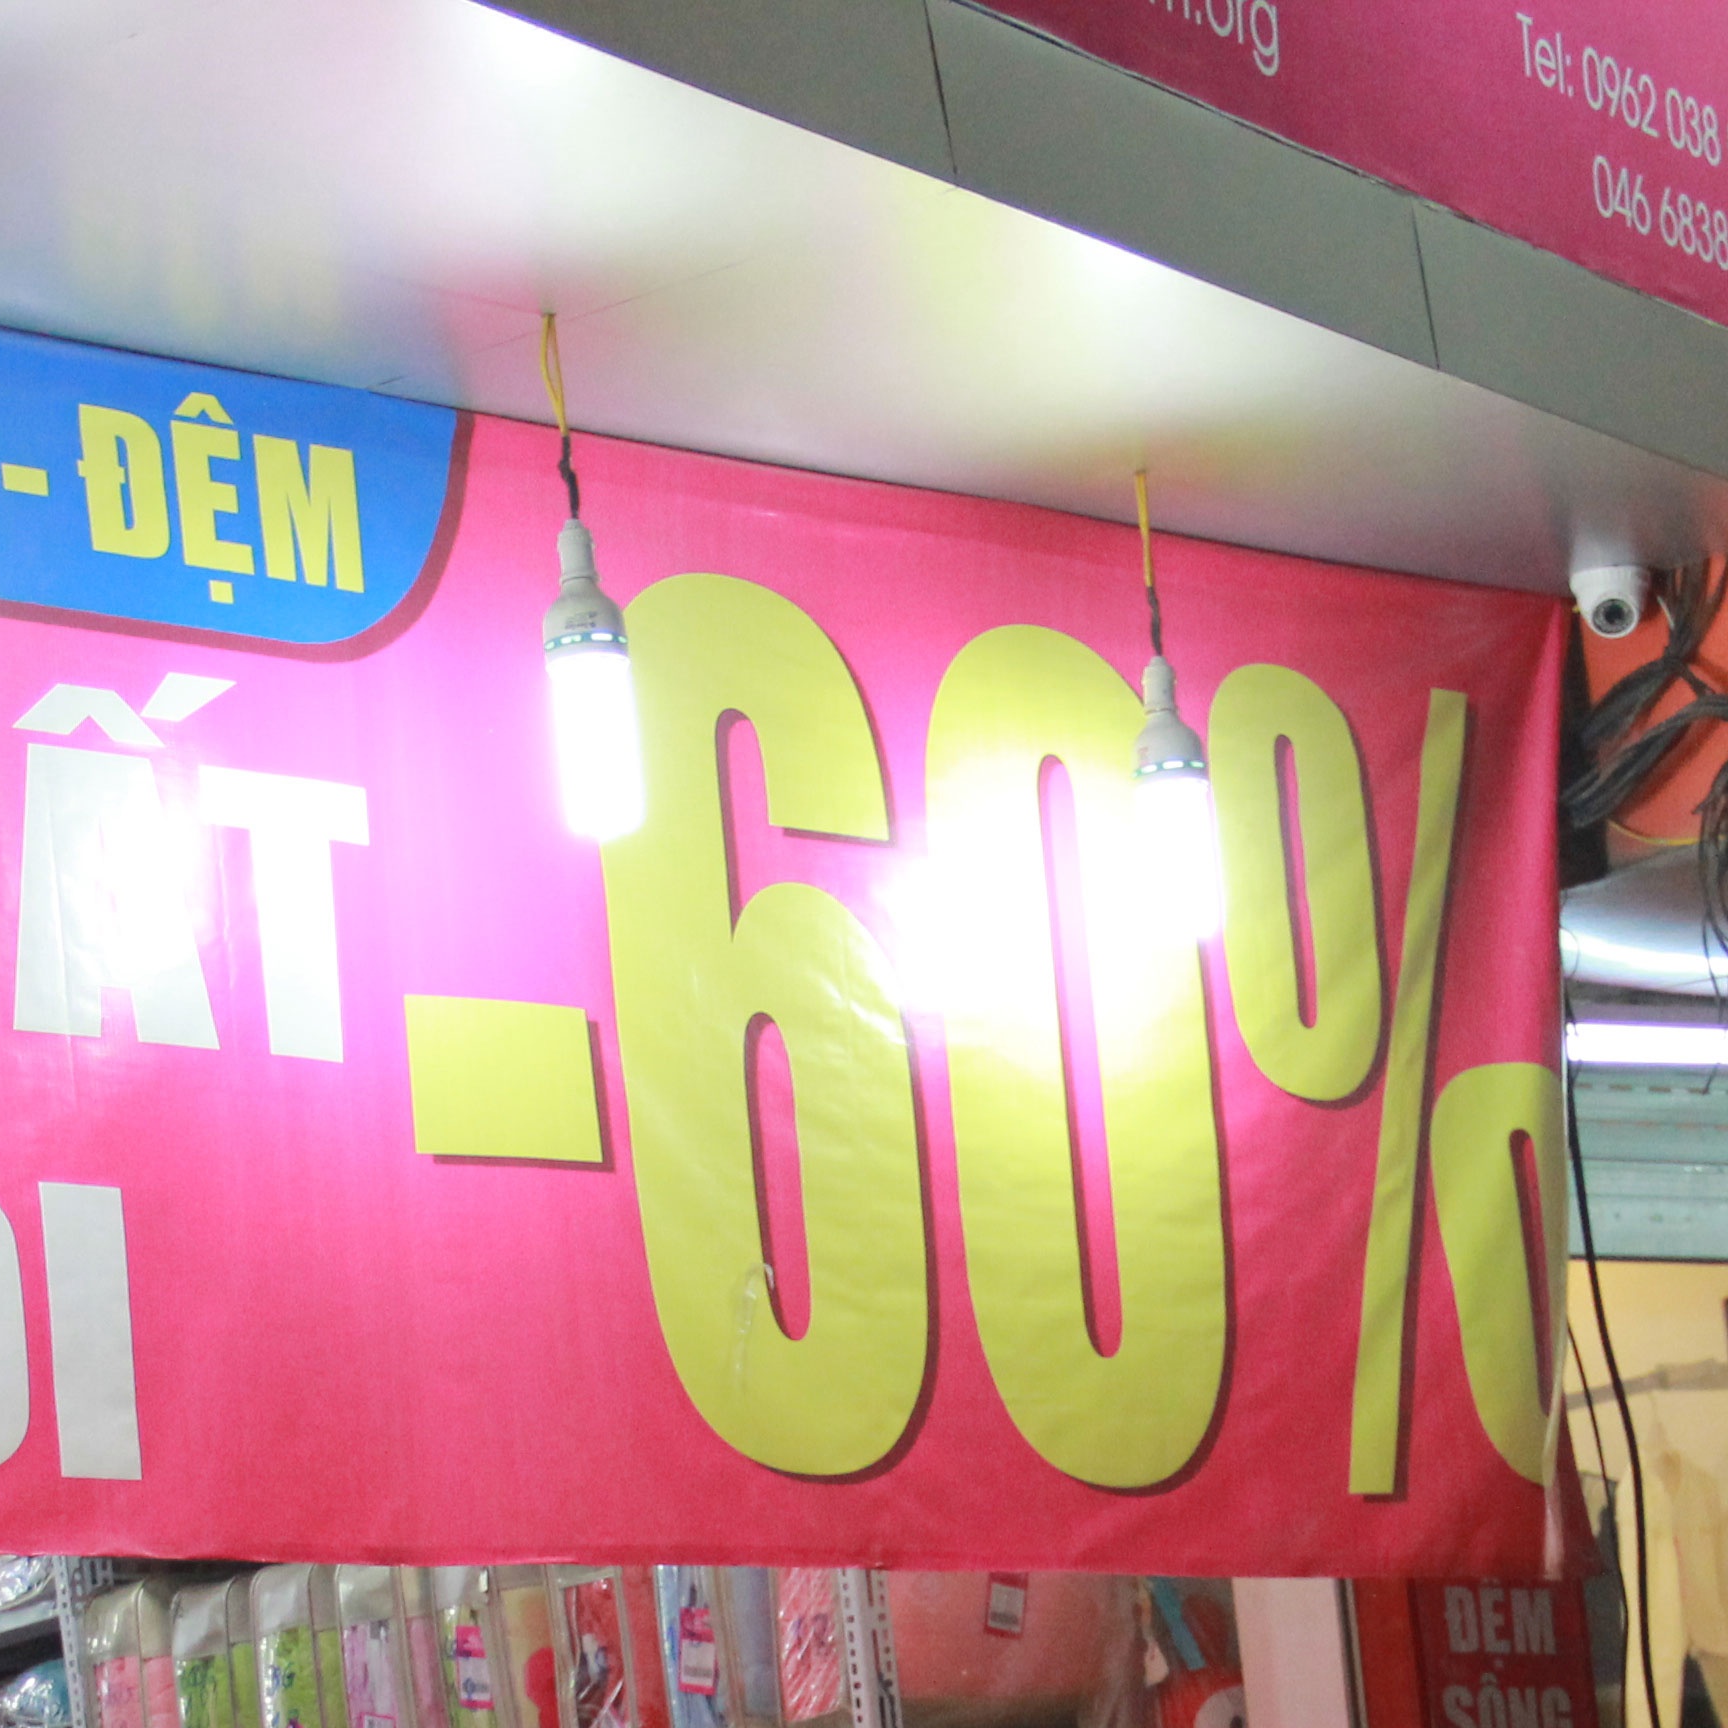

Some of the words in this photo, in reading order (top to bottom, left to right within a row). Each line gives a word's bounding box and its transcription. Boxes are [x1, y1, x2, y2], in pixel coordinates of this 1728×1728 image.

[1516, 11, 1575, 98] Tel:
[1582, 46, 1660, 138] 0962
[1665, 87, 1722, 167] 038
[1592, 154, 1653, 236] 046
[77, 391, 366, 604] ĐỆM
[403, 572, 1570, 1492] -60%
